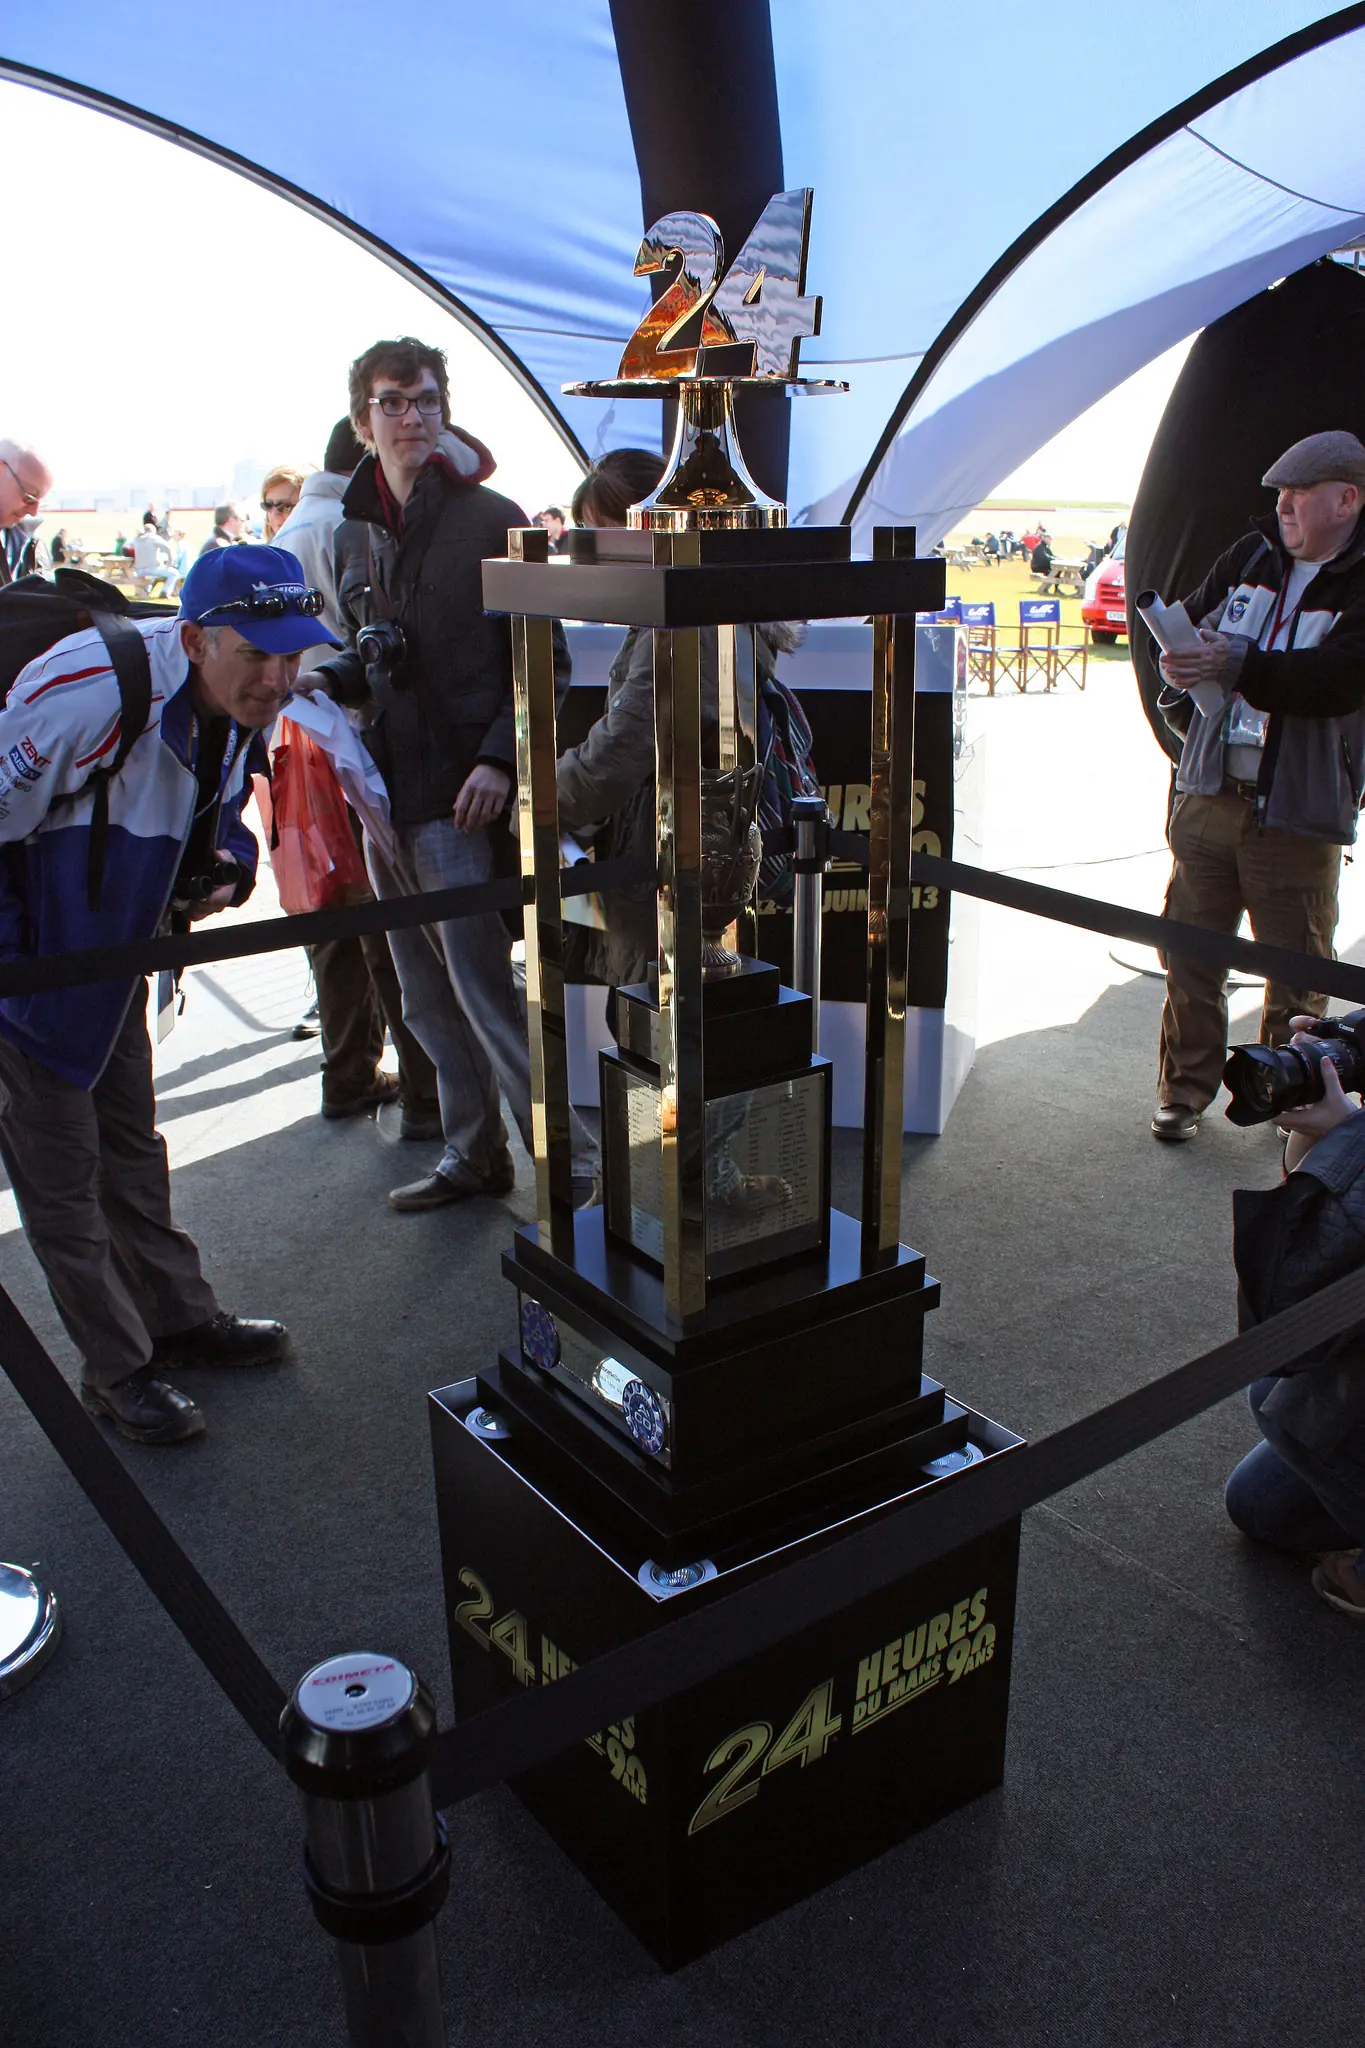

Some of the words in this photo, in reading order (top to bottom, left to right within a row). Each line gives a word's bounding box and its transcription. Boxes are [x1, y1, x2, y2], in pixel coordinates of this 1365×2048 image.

[617, 187, 823, 378] 24
[21, 735, 51, 768] ZENT
[454, 1566, 536, 1688] 24
[853, 1690, 881, 1726] DU
[887, 1654, 942, 1704] MANS
[947, 1623, 996, 1685] 90
[963, 1642, 995, 1675] ANS
[688, 1677, 842, 1836] 24
[856, 1587, 988, 1701] HEURES
[622, 1771, 647, 1805] ANS
